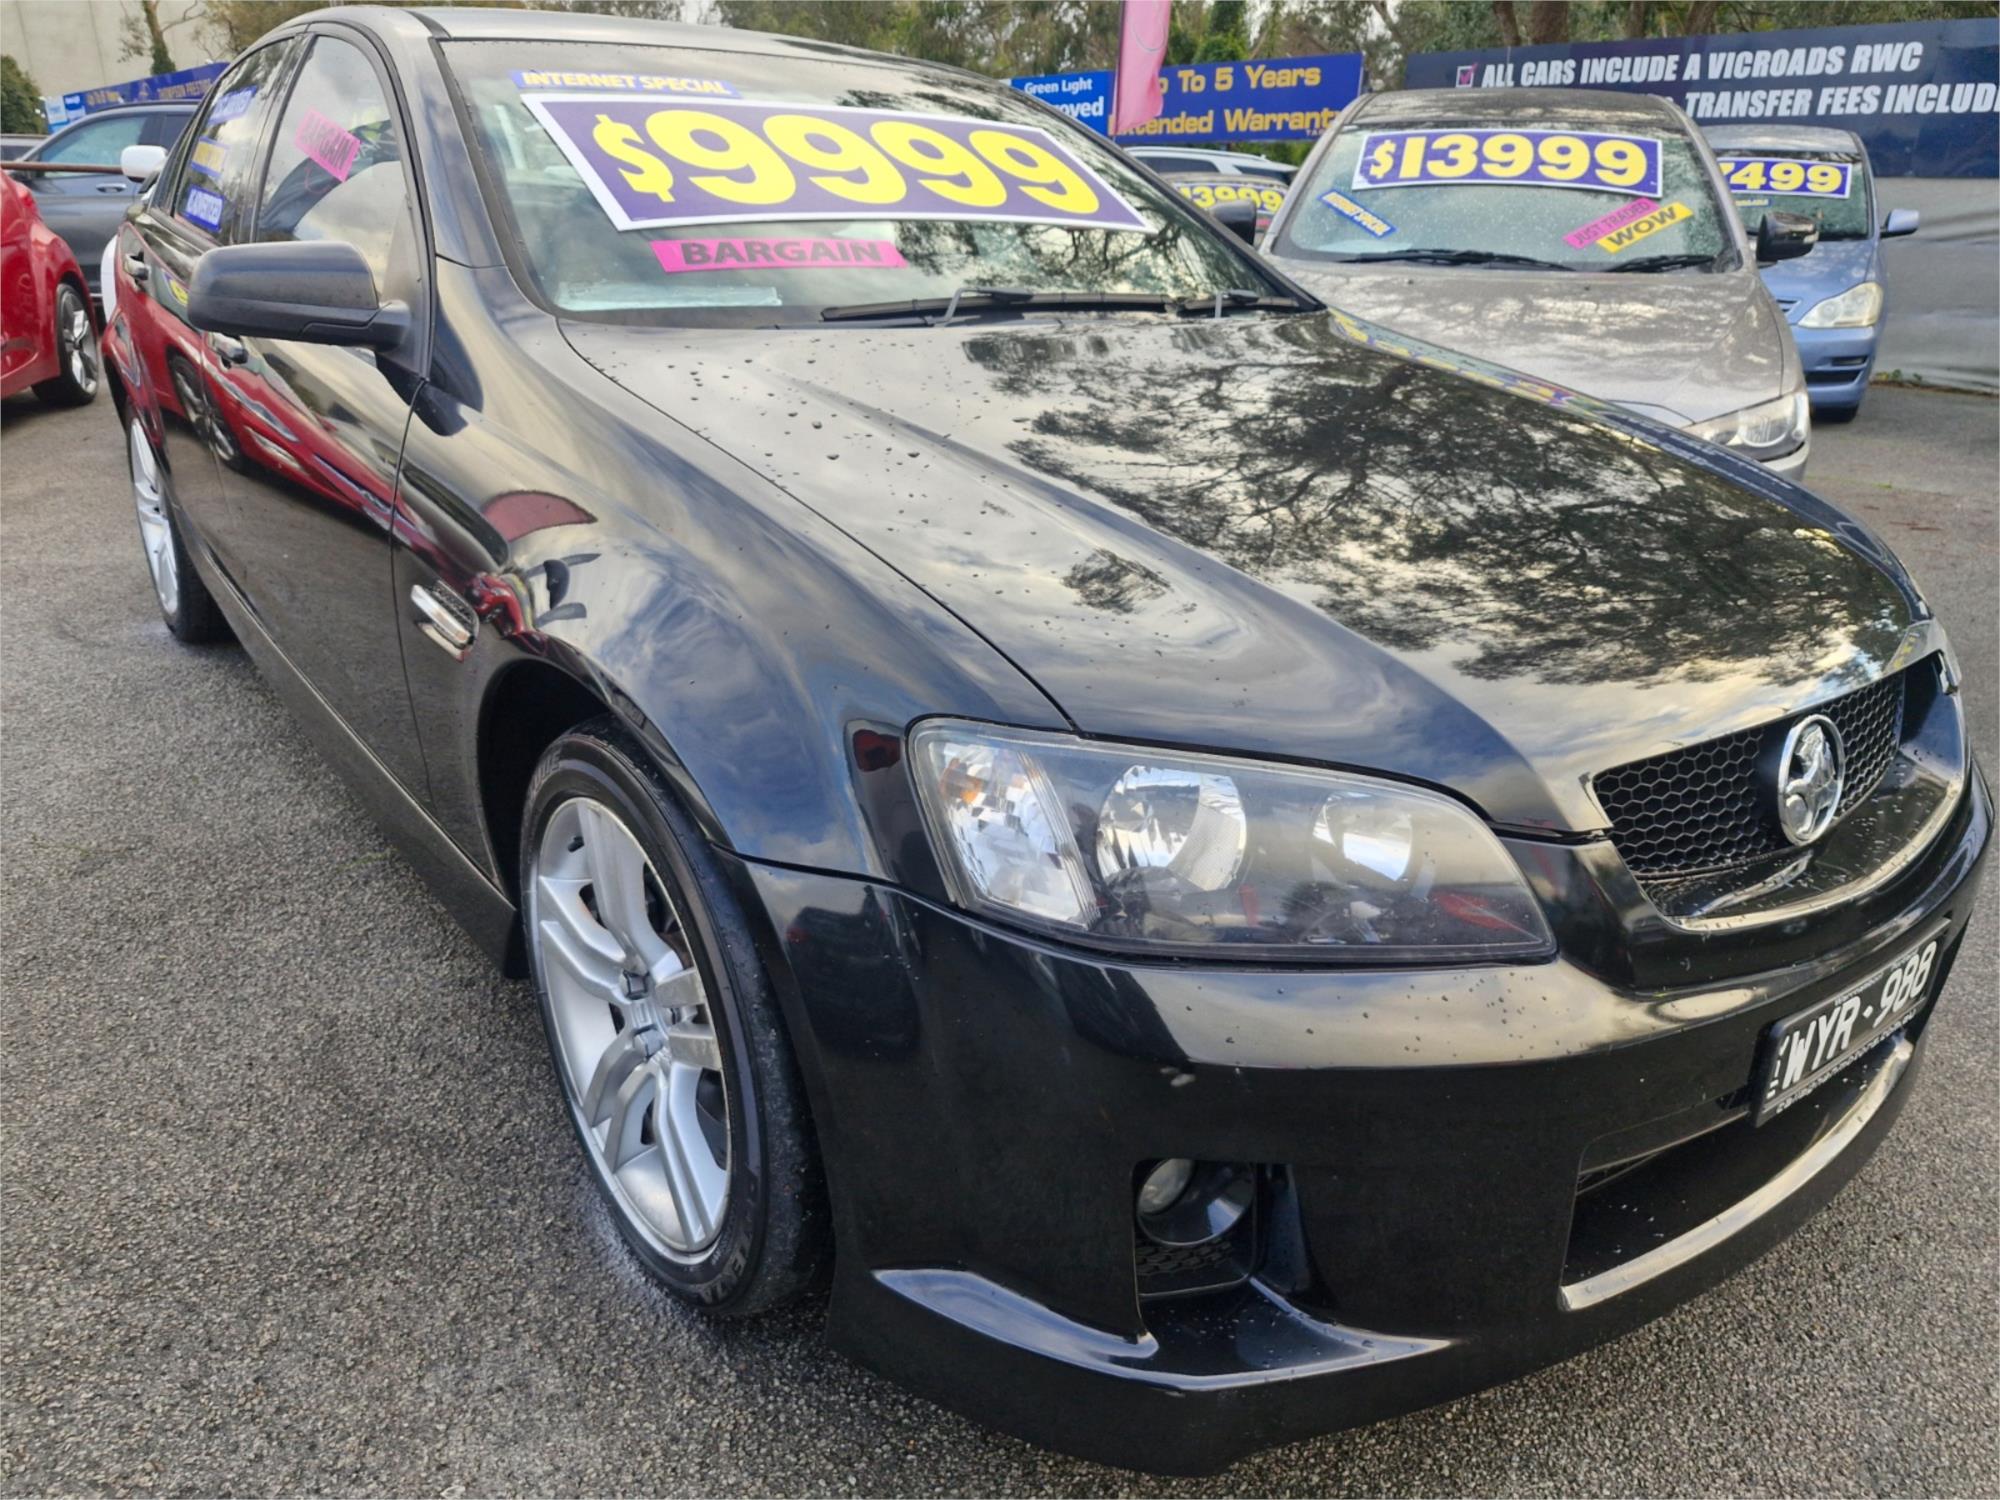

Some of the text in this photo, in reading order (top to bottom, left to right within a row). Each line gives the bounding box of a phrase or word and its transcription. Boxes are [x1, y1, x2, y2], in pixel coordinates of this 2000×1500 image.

[1177, 69, 1206, 93] To
[1214, 66, 1234, 91] 5
[1245, 64, 1321, 89] Years
[1481, 41, 1924, 88] ALL CARS INCLUDE A VICROADS RWC
[521, 72, 733, 95] INTERNET SPECIAL
[1024, 77, 1093, 96] Green Light
[1685, 88, 1814, 118] TRANSFER
[1816, 85, 1882, 115] FEES
[1224, 107, 1340, 132] Warrant
[592, 110, 1100, 214] $9999
[1369, 133, 1648, 187] $13999
[1607, 206, 1676, 246] WOW
[680, 241, 882, 265] BARGAIN
